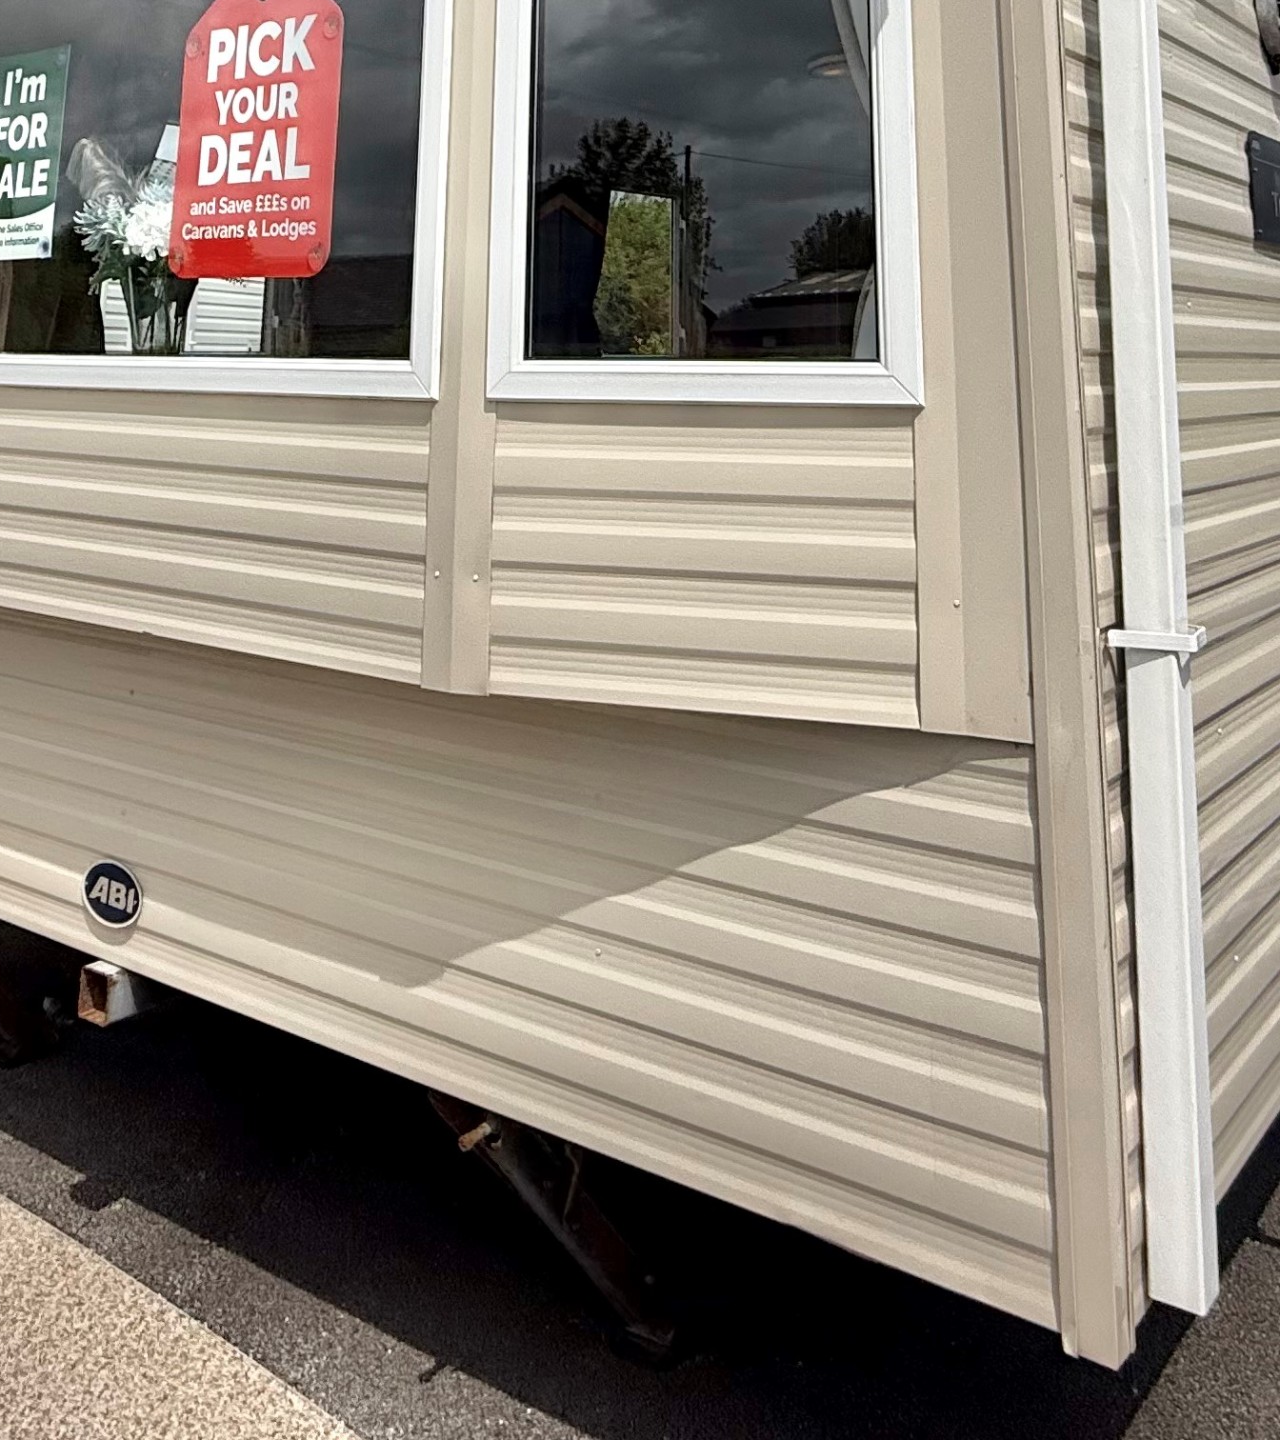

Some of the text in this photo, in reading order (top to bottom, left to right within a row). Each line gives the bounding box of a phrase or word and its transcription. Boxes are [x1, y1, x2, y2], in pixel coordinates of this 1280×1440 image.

[207, 13, 318, 83] PICK
[4, 68, 47, 106] I'm
[215, 82, 299, 125] YOUR
[197, 127, 310, 186] DEAL
[190, 193, 310, 215] and Save £££s on
[7, 223, 23, 233] Sales
[182, 217, 317, 241] Caravans & Lodges
[88, 876, 136, 914] ABI
